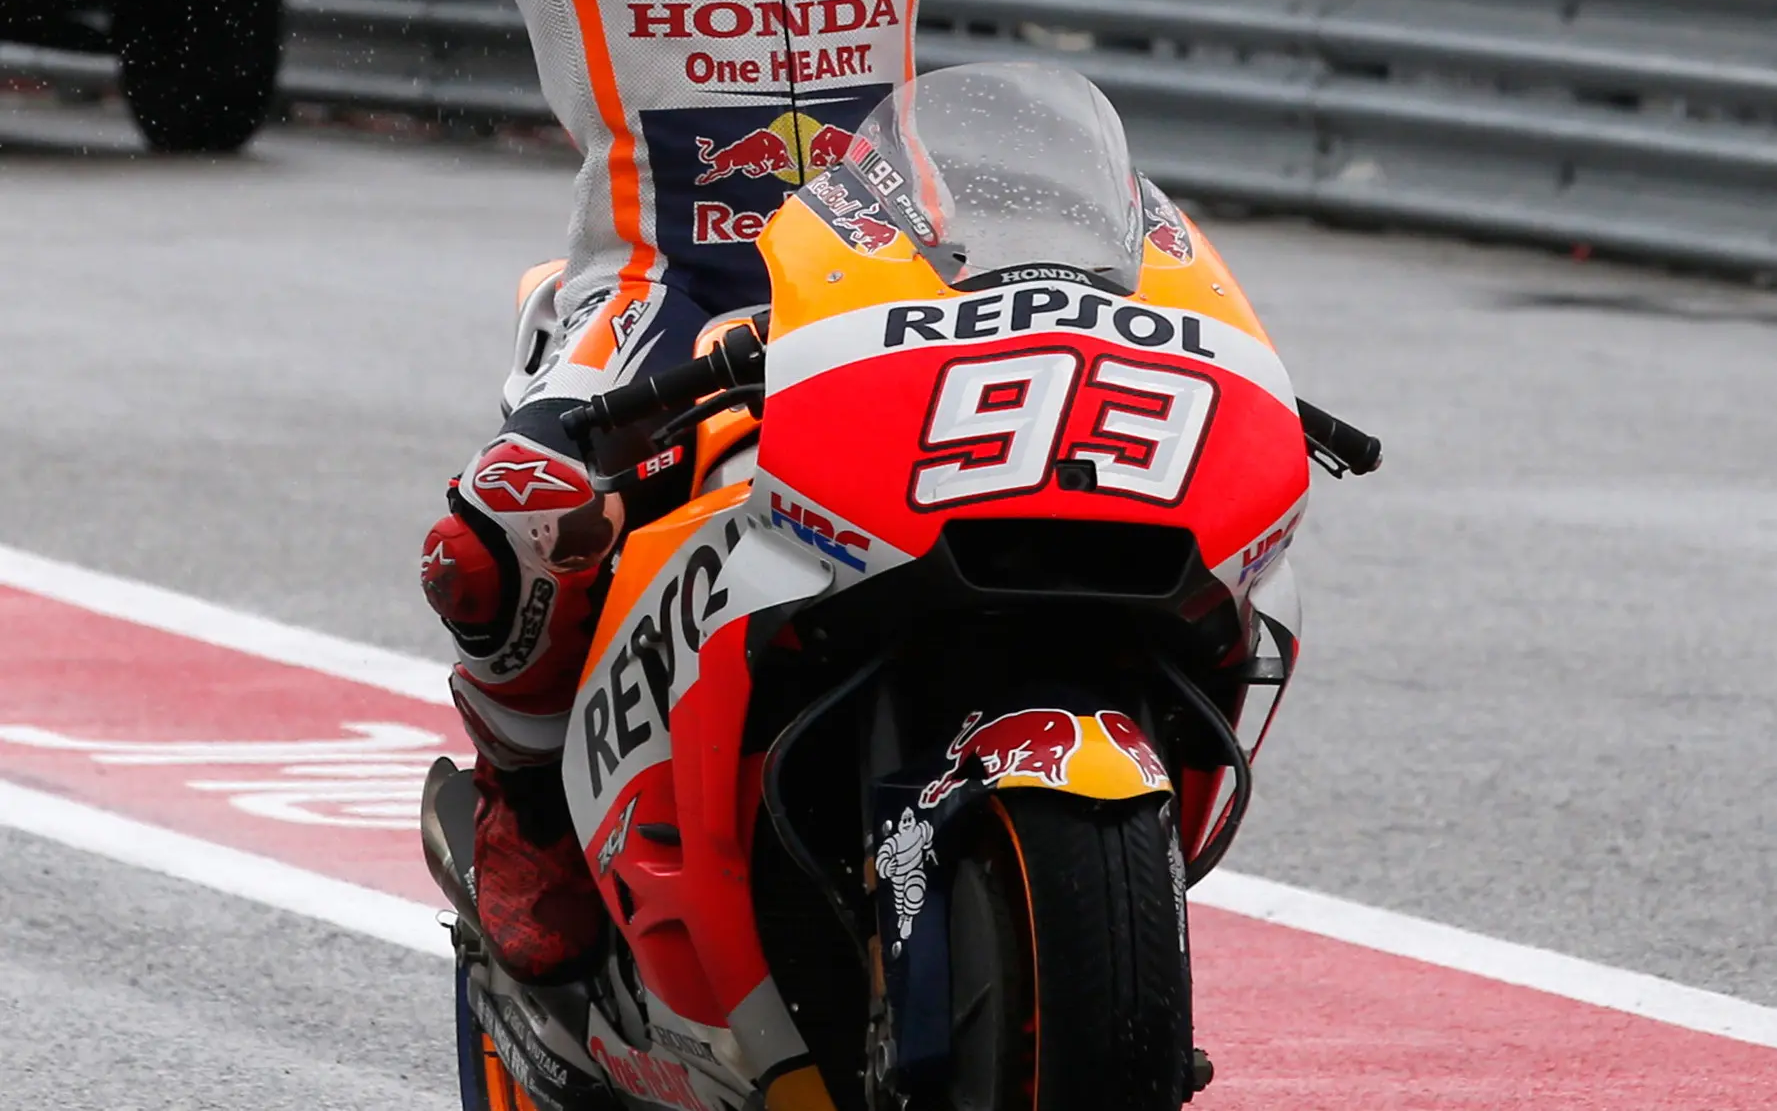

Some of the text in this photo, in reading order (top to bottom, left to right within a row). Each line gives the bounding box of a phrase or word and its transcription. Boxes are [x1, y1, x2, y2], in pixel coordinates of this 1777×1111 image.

[685, 51, 761, 84] One
[868, 160, 905, 197] 93
[896, 194, 932, 237] Puig
[1000, 268, 1093, 286] HONDA
[883, 287, 1215, 358] REPSOL
[905, 345, 1222, 513] 93
[645, 449, 675, 477] 93
[770, 490, 872, 574] HRC
